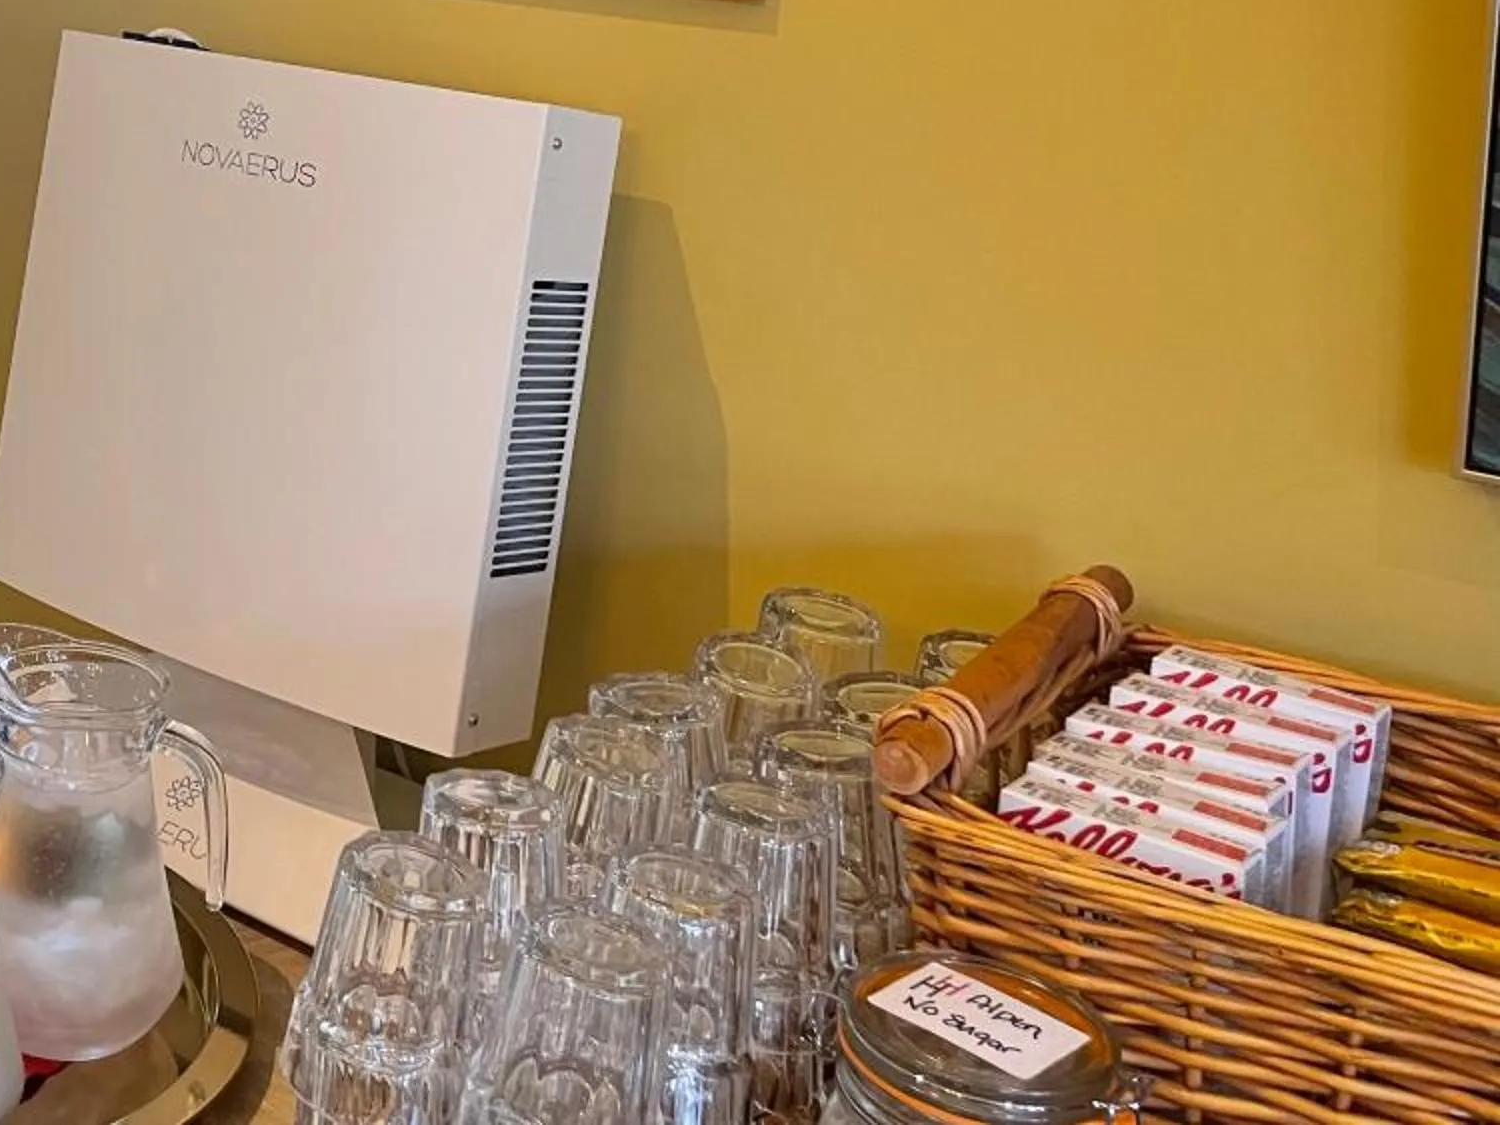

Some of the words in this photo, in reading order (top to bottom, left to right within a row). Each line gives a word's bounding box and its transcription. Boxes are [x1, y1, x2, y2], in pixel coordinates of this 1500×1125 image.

[181, 139, 317, 188] NOVAERUS
[903, 995, 940, 1017] No
[966, 993, 1043, 1041] Alpen
